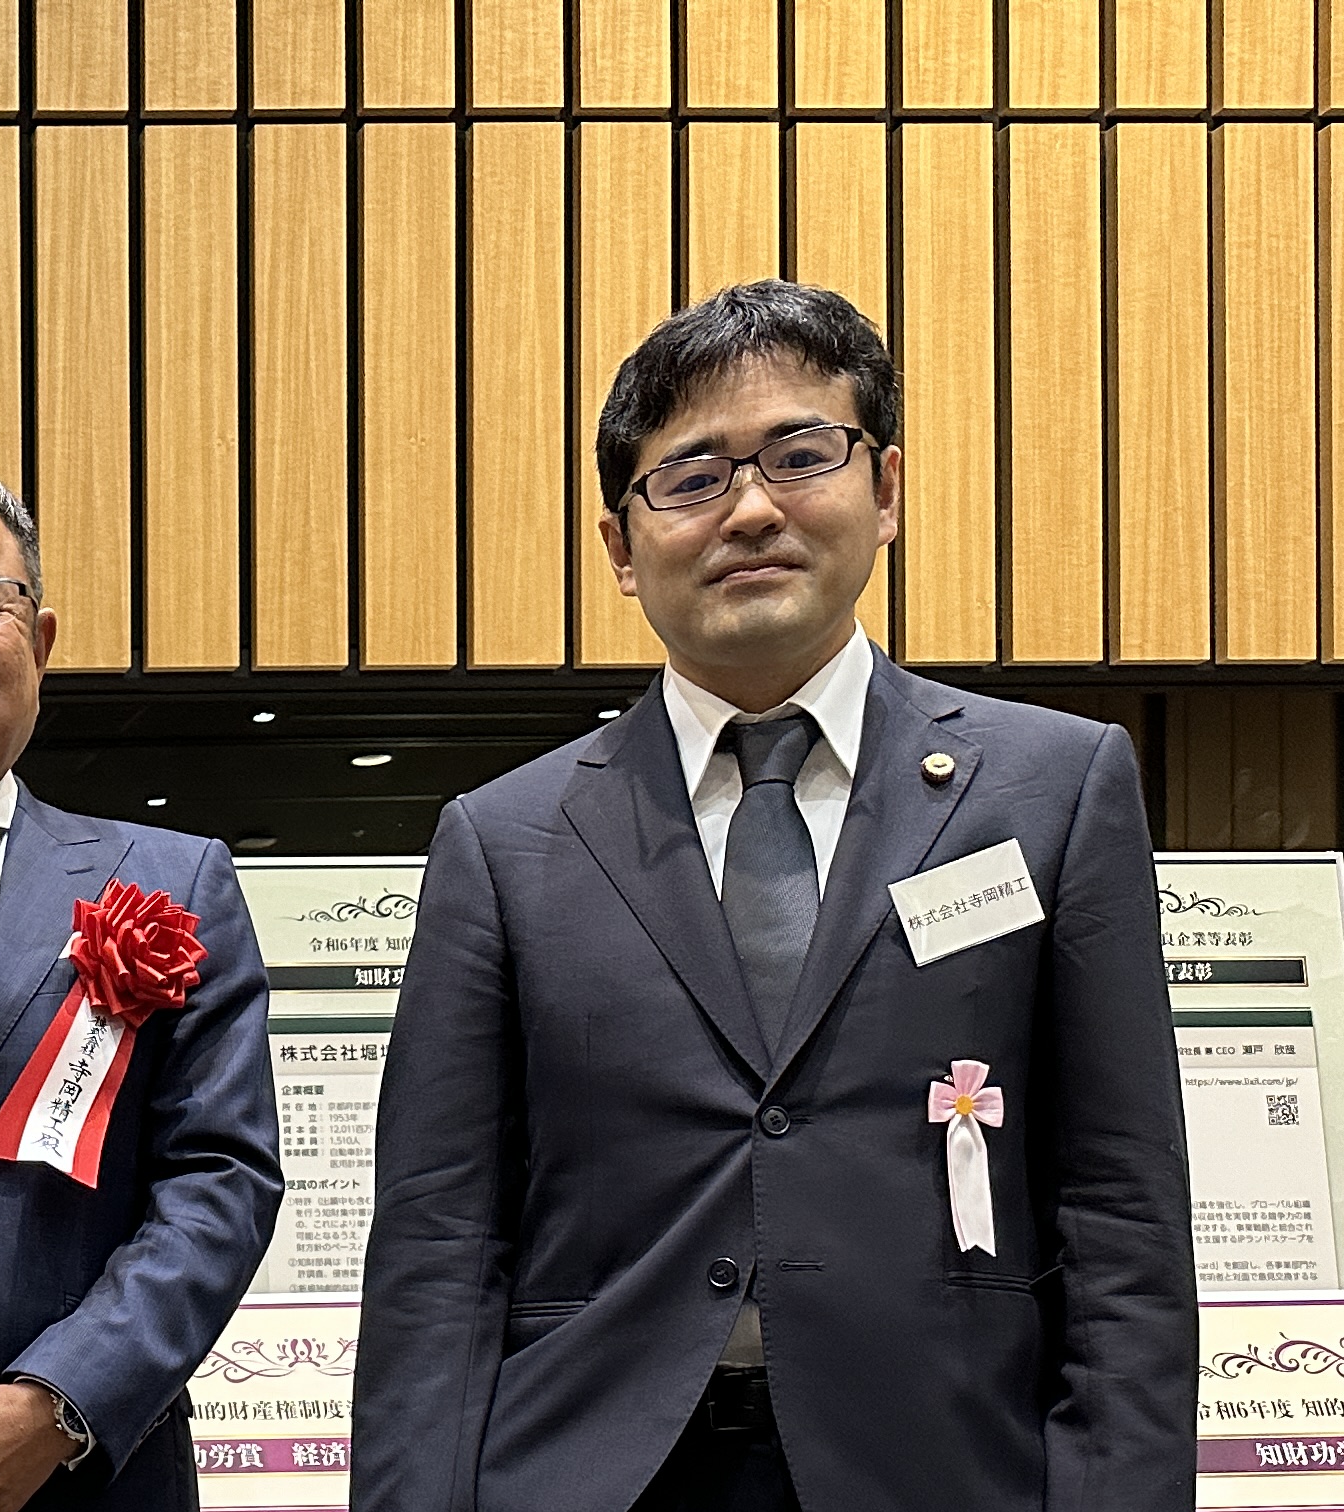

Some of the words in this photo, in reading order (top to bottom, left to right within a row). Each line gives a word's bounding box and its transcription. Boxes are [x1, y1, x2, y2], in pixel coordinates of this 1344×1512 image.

[908, 877, 1029, 931] 株式会社寺岡精工
[310, 937, 379, 952] 令和6年度
[1216, 1046, 1235, 1055] CEO
[281, 1085, 324, 1096] 企業概要
[286, 1180, 360, 1190] 受賞のポイント
[1255, 1441, 1344, 1467] 知財功
